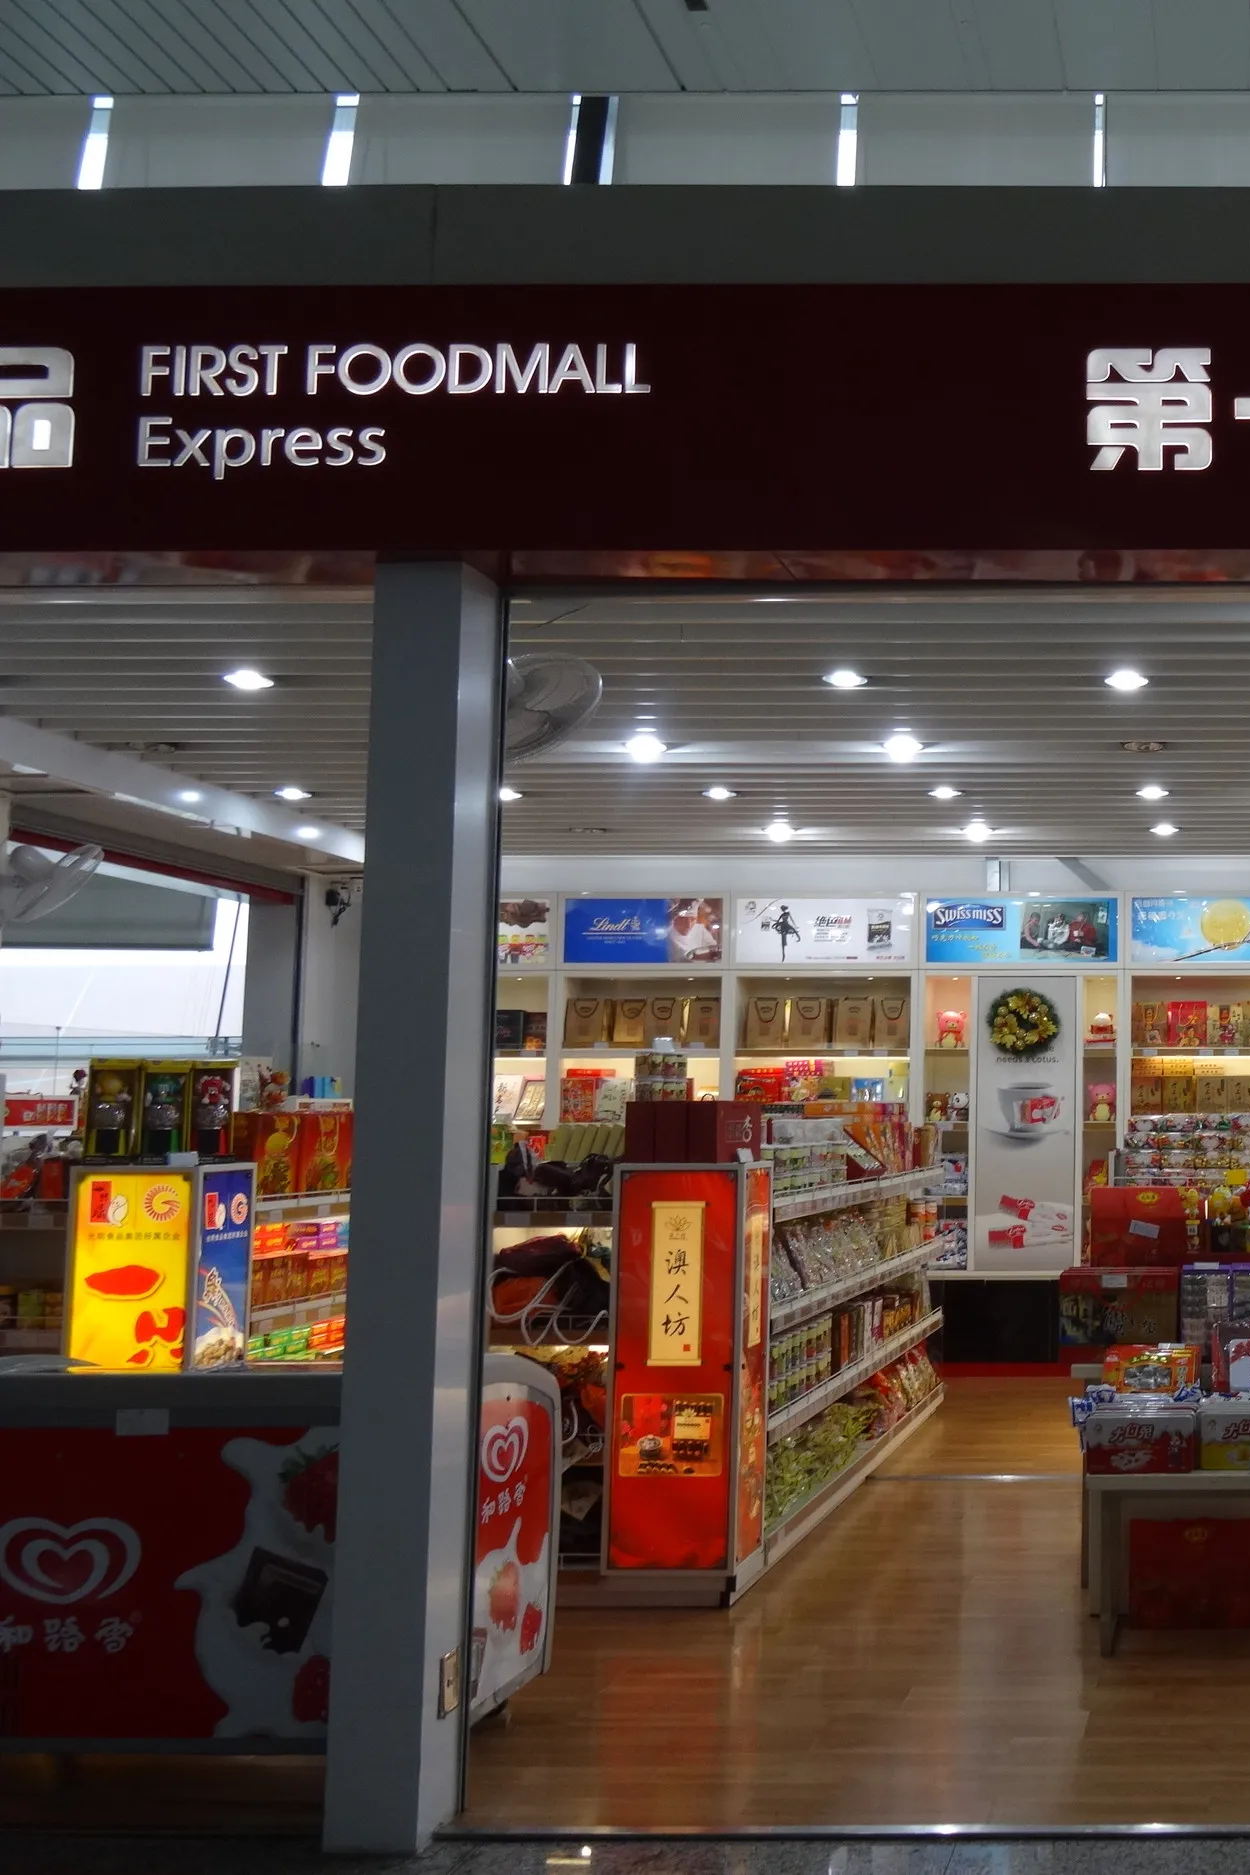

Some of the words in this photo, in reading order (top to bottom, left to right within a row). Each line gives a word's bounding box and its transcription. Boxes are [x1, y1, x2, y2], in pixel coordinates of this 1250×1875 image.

[142, 345, 288, 396] FIRST
[307, 343, 650, 395] FOODMALL
[139, 417, 386, 479] Express
[590, 917, 632, 932] Lindt
[661, 1248, 691, 1337] 澳人坊
[481, 1481, 526, 1524] 和路雪
